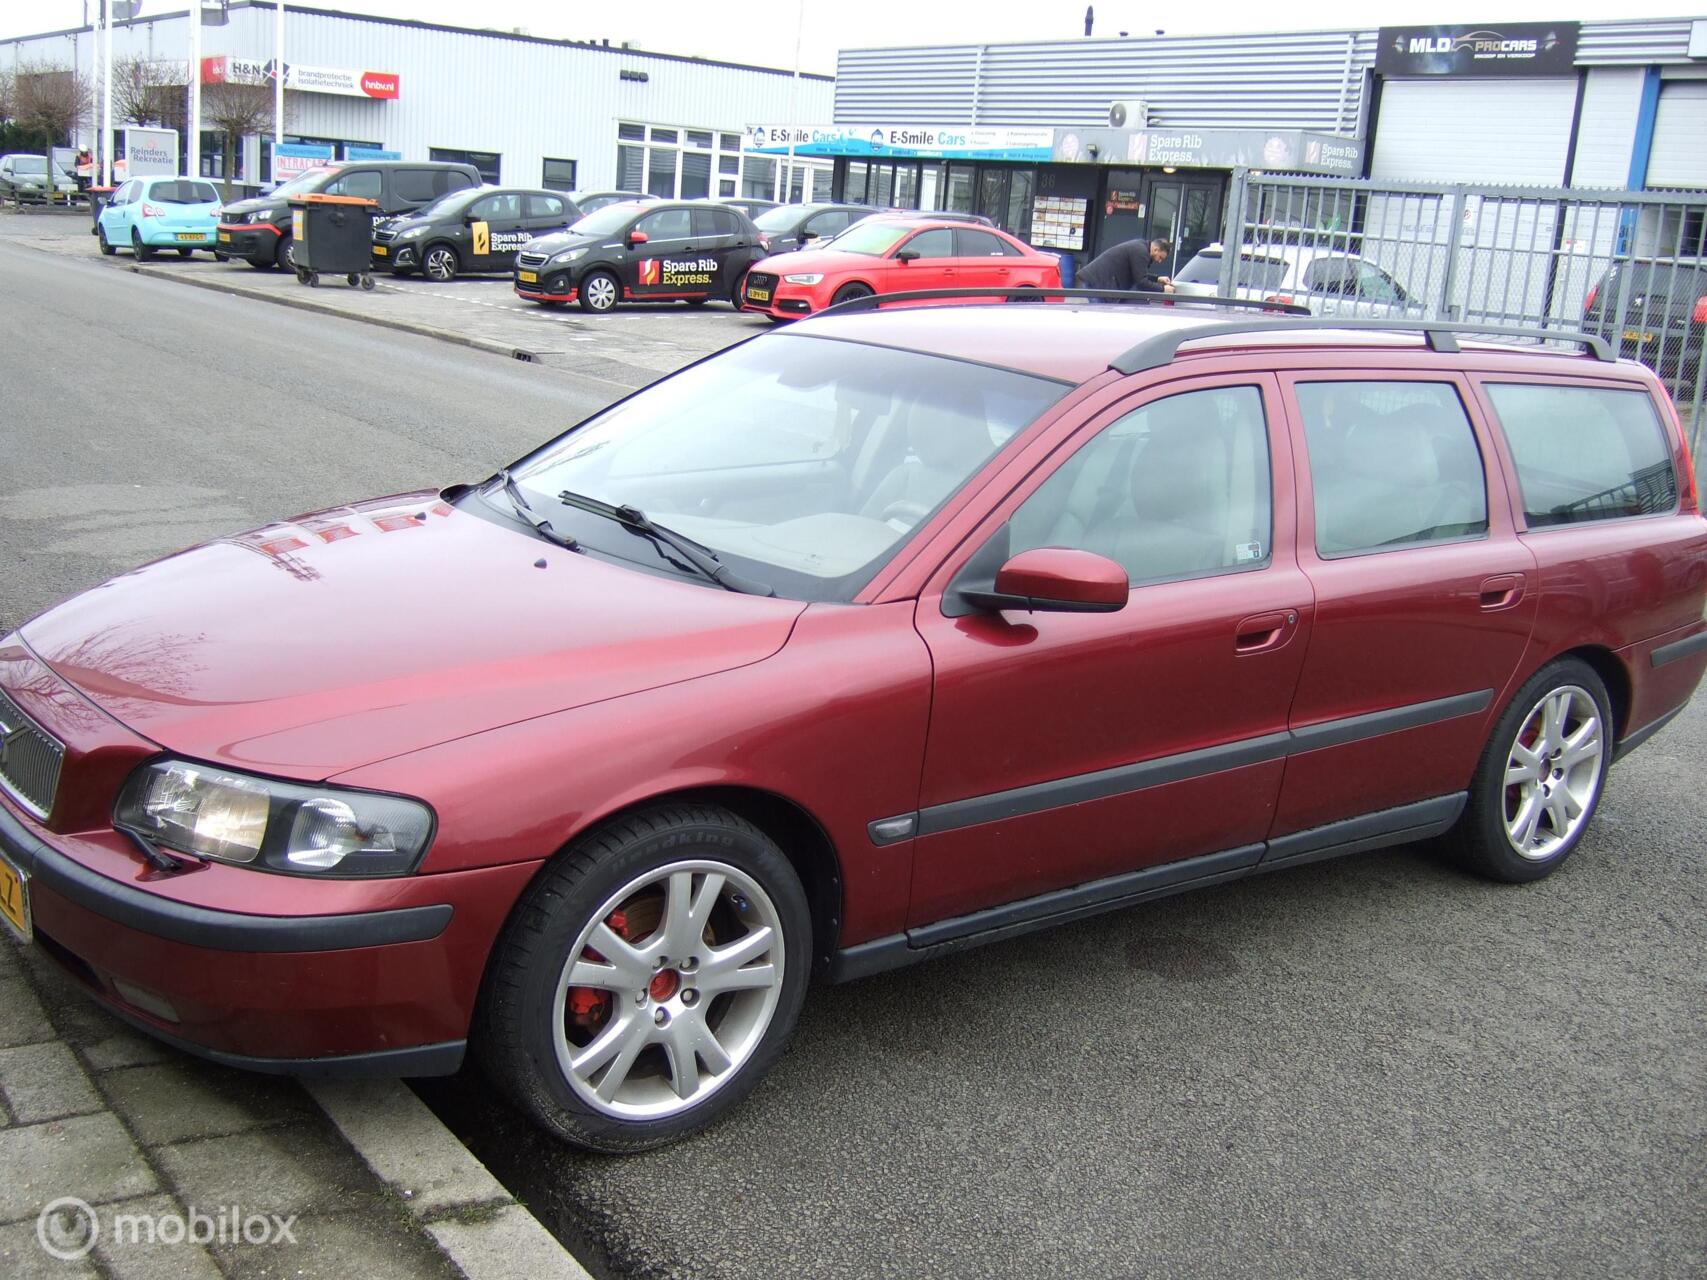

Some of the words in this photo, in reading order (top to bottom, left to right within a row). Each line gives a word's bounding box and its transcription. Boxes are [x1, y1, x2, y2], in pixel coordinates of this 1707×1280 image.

[1409, 38, 1451, 53] MLD
[1474, 40, 1537, 51] PROCARS
[233, 62, 261, 75] H&N
[298, 69, 352, 82] brandprotectie
[298, 77, 354, 89] isolatietechniek
[365, 80, 395, 92] hnbv.nl
[812, 131, 836, 145] Cars
[890, 131, 934, 145] E-Smile
[938, 132, 966, 146] Cars
[1150, 135, 1182, 149] Spare
[1183, 135, 1202, 148] Rib
[130, 147, 168, 157] Reinders
[1149, 149, 1195, 164] Express.
[1321, 144, 1344, 158] Spare
[1344, 146, 1358, 159] Rib
[133, 154, 174, 164] Rekreatie
[1320, 156, 1354, 169] Express.
[491, 232, 517, 243] Spare
[517, 232, 533, 242] Rib
[663, 260, 697, 274] Spare
[698, 259, 718, 271] Rib
[663, 273, 712, 286] Express.
